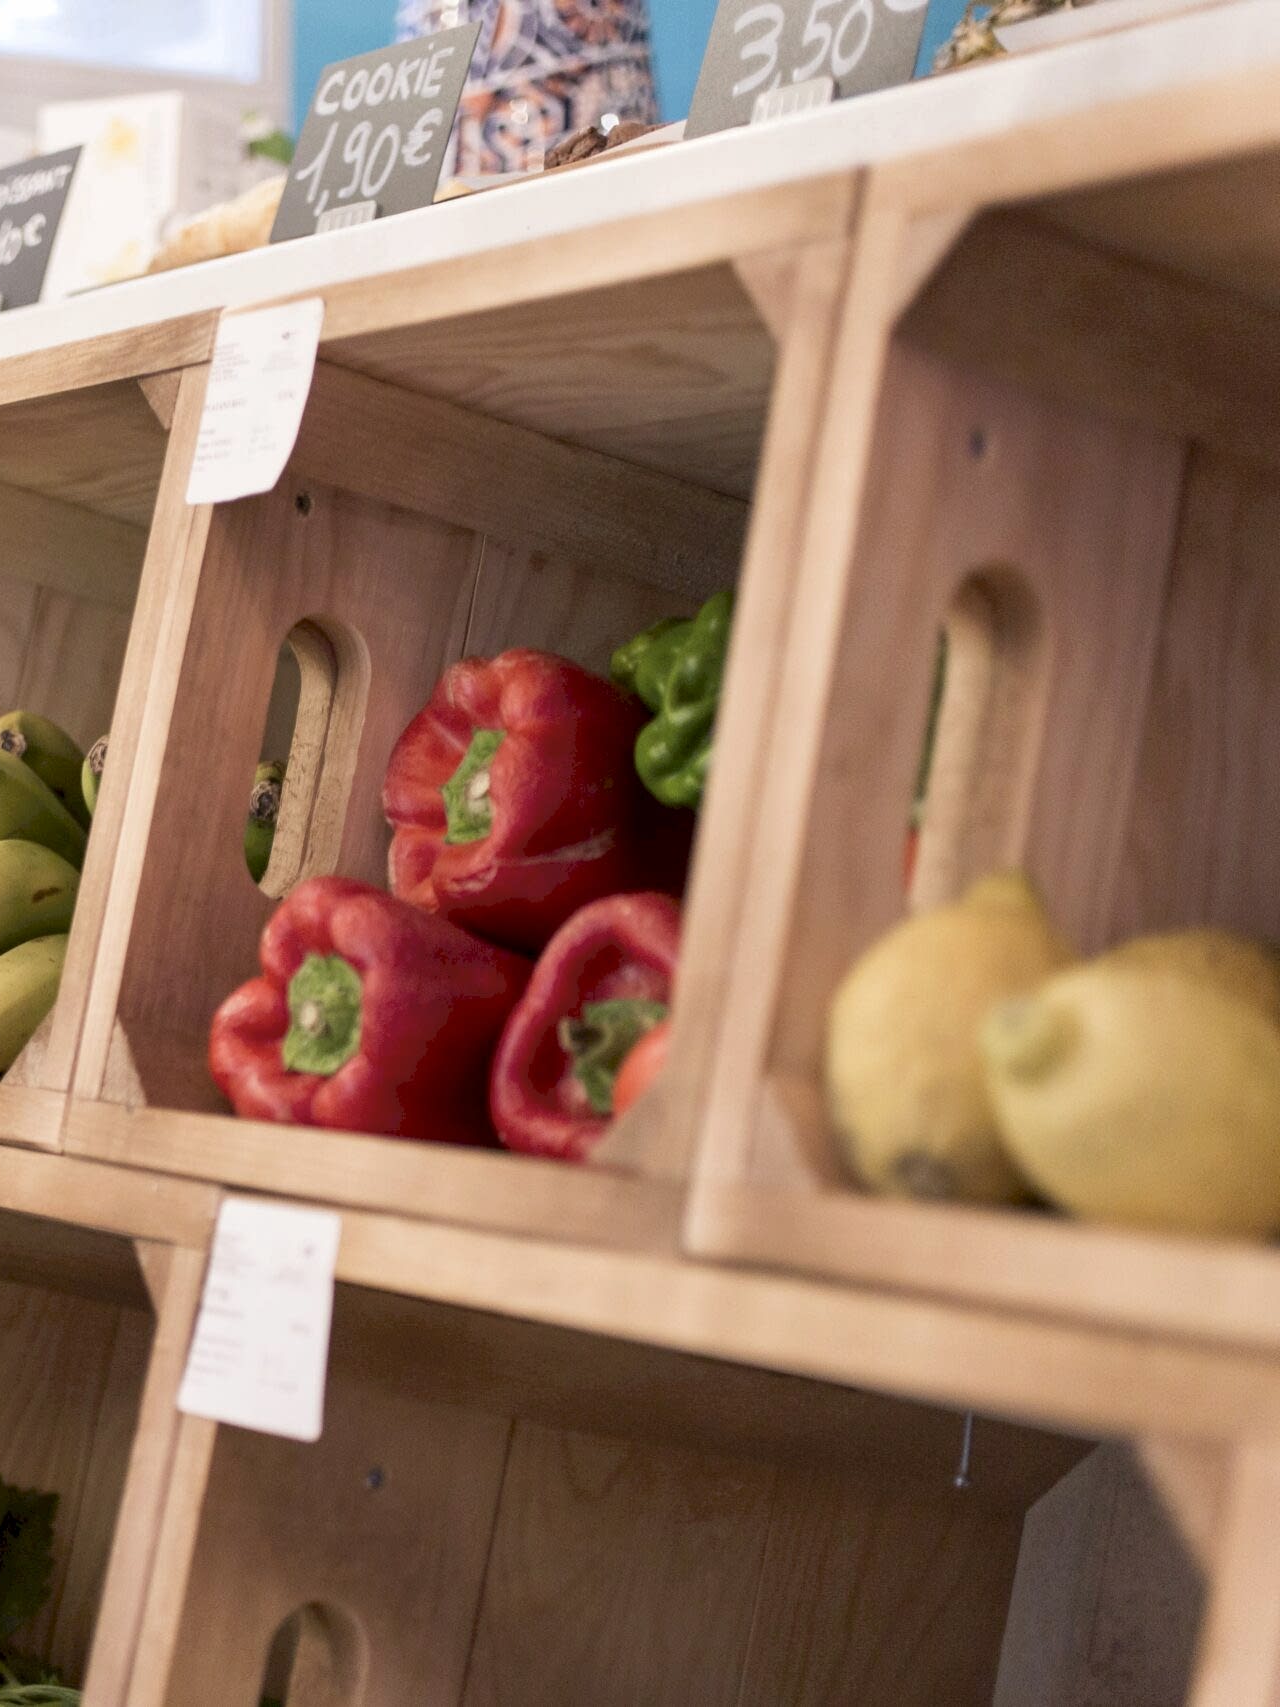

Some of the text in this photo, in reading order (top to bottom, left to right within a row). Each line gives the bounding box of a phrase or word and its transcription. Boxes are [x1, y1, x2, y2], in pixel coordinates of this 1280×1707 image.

[315, 43, 455, 116] COOKIE
[732, 0, 926, 97] 3,50
[294, 107, 444, 217] 1,90€
